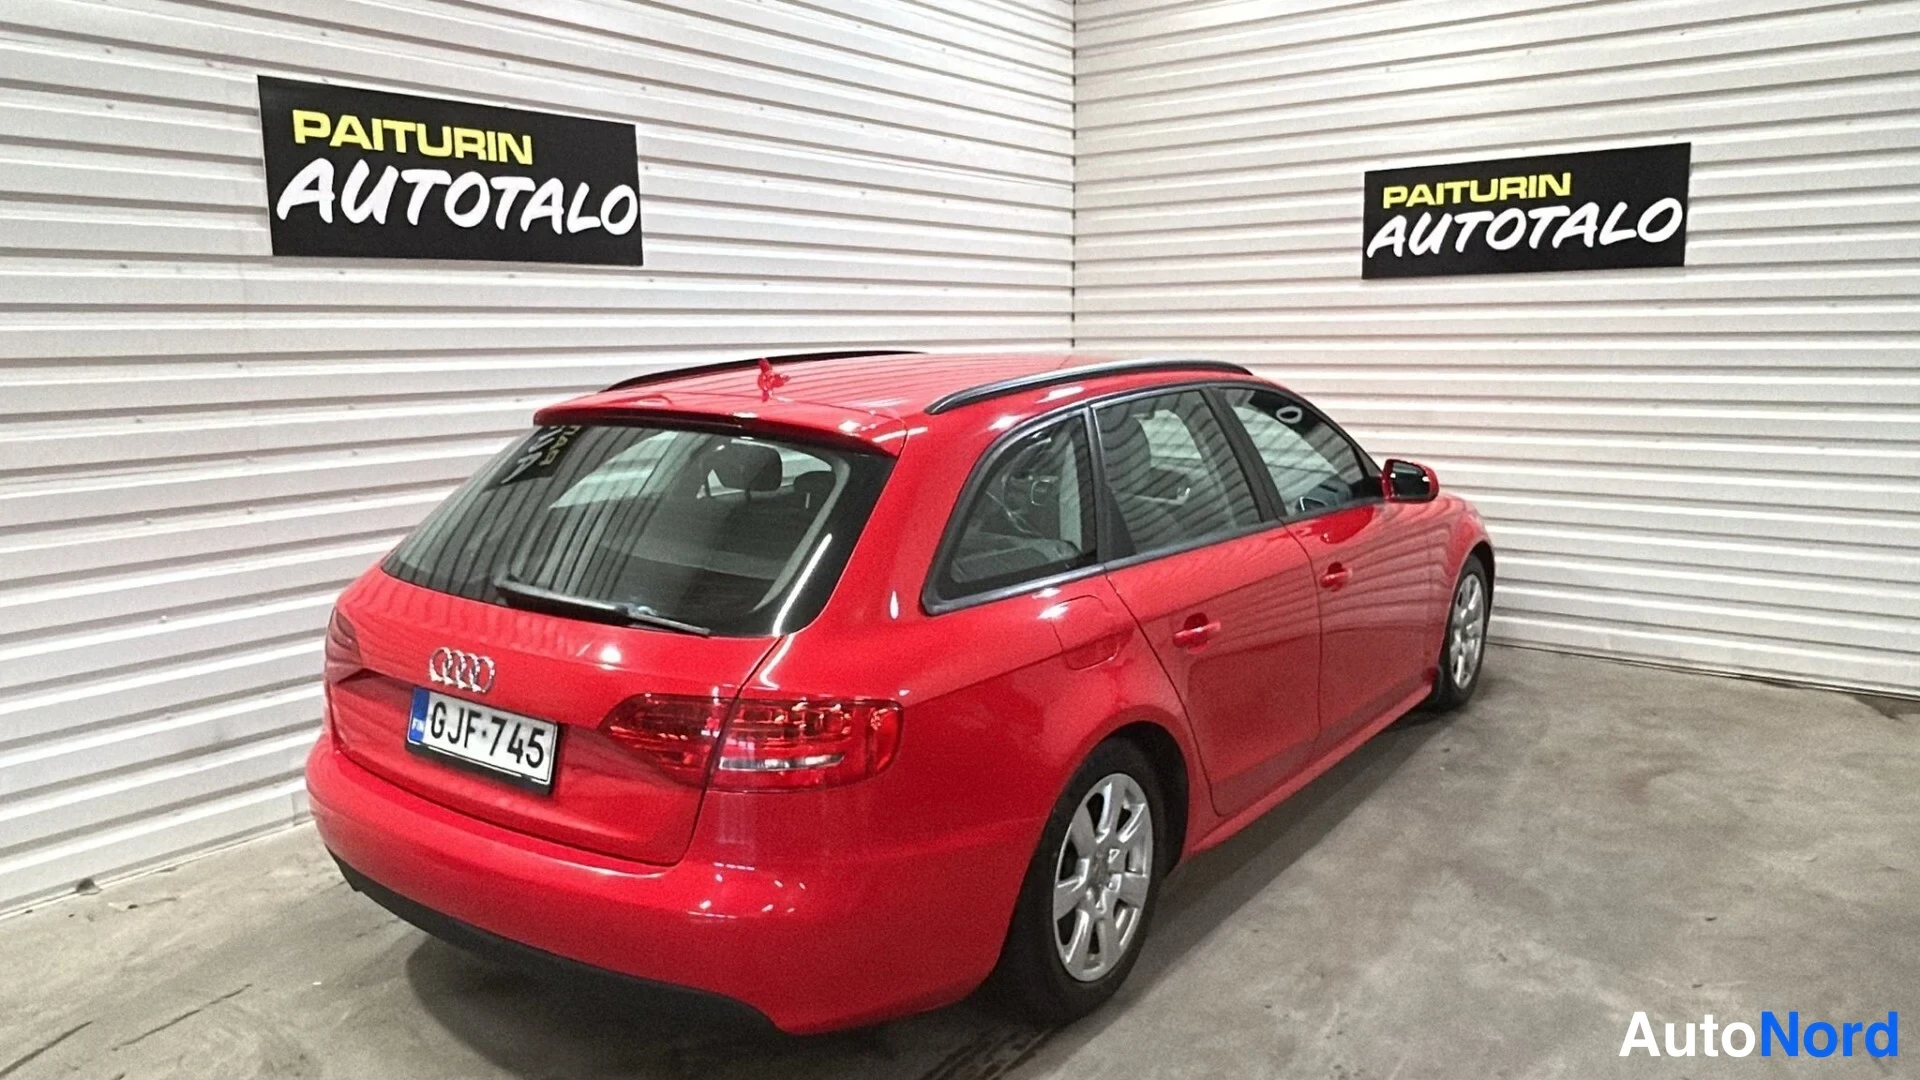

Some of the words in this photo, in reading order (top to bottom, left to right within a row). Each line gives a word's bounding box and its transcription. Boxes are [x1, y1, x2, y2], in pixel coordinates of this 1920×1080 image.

[292, 109, 533, 165] PAITURIN
[276, 157, 639, 236] AUTOTALO
[1383, 172, 1571, 209] PAITURIN
[1366, 197, 1683, 258] AUTOTALO
[430, 701, 545, 769] GJF-745
